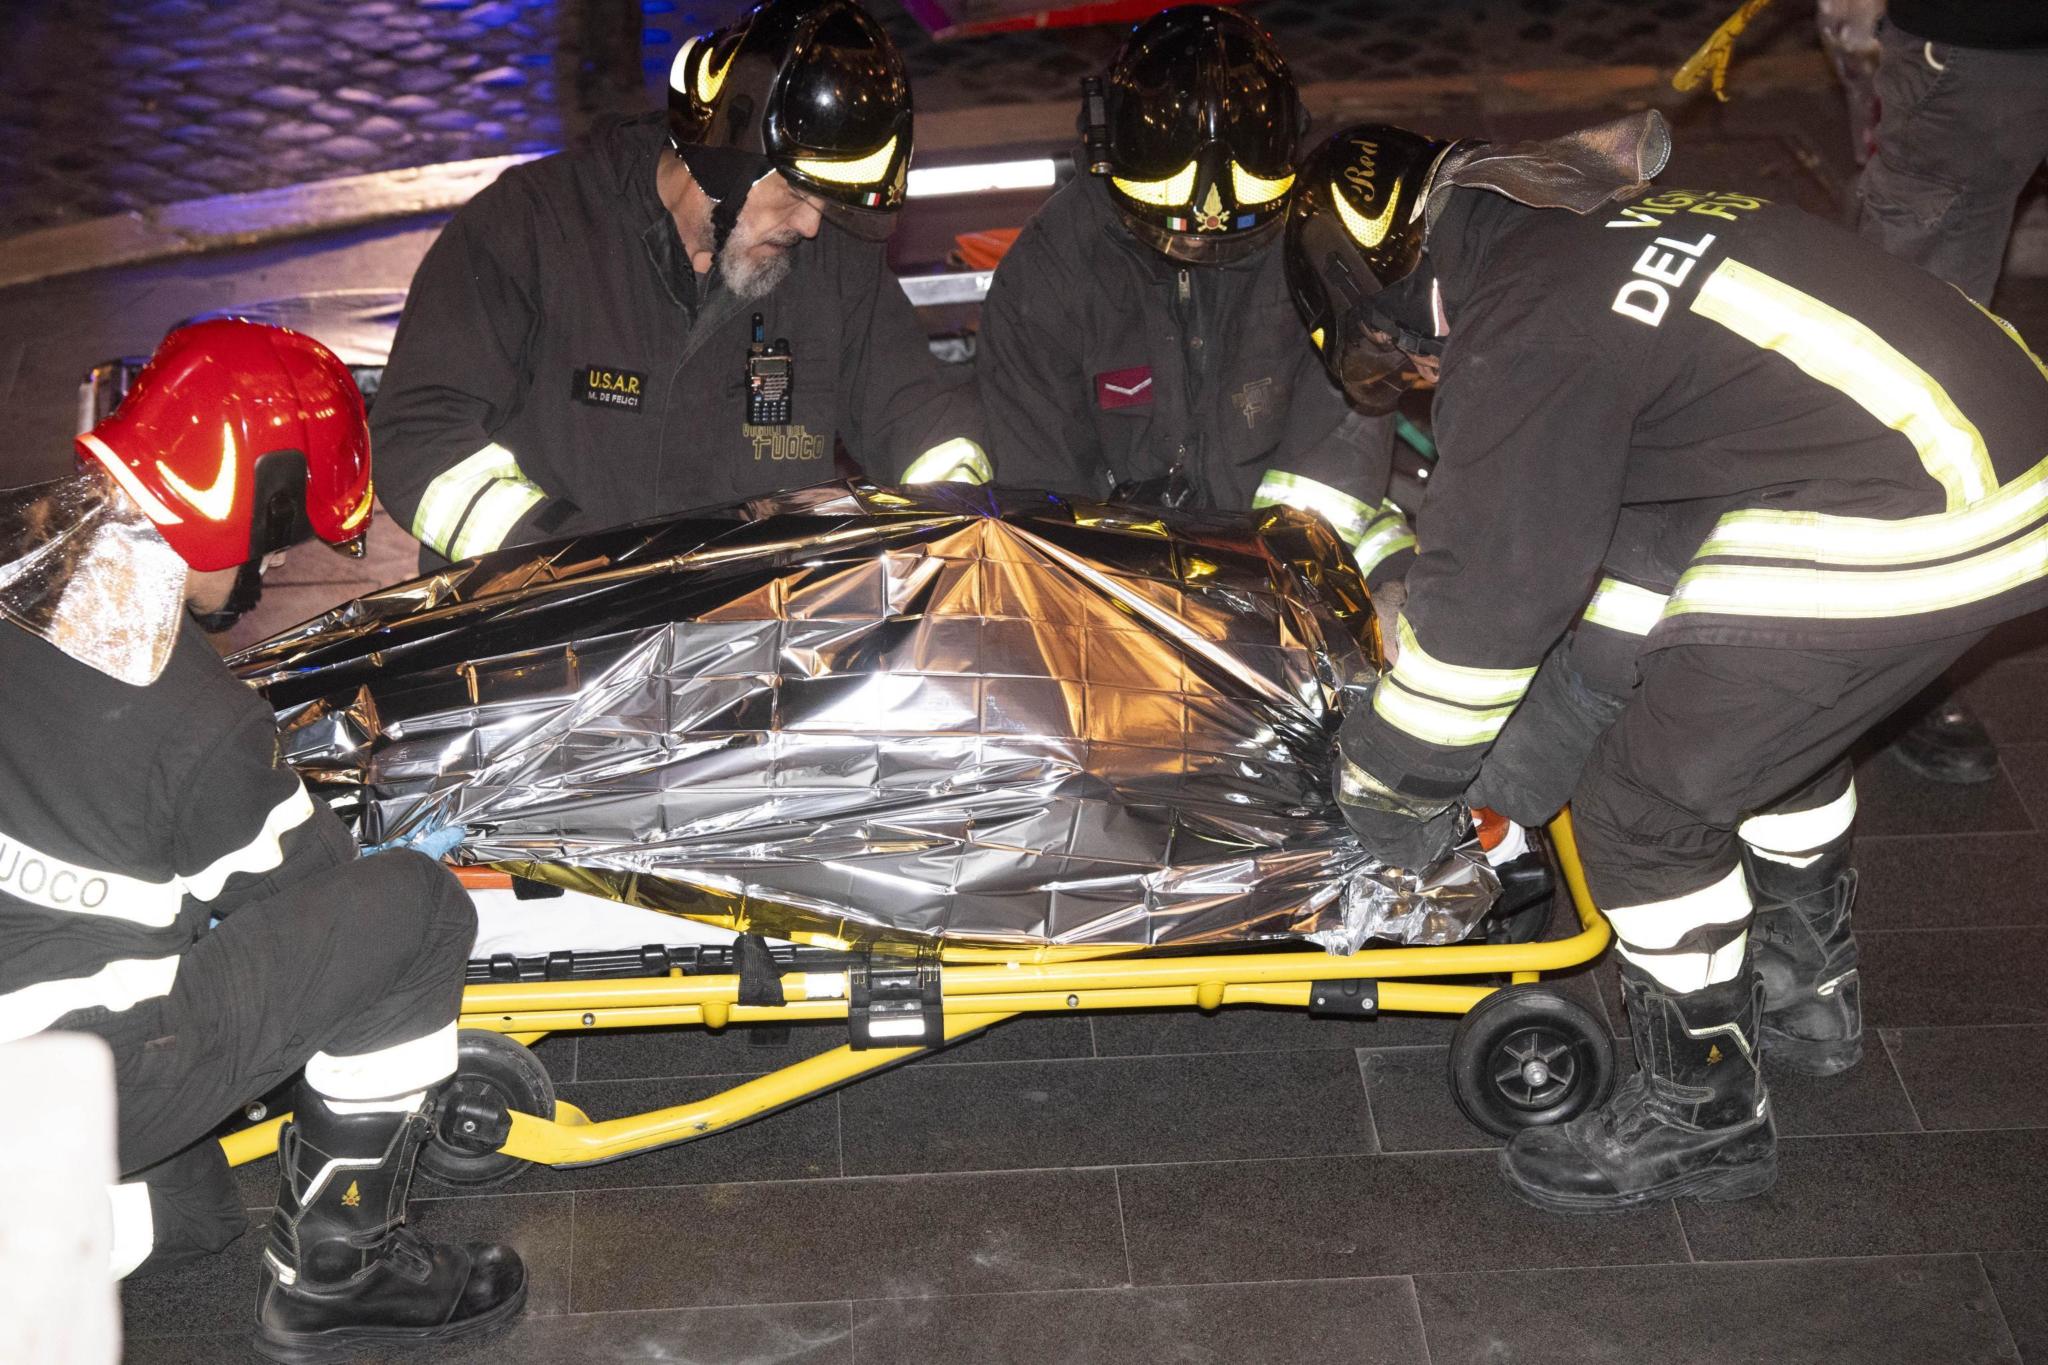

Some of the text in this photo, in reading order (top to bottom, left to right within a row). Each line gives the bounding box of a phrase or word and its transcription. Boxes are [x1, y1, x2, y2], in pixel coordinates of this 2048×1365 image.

[1611, 233, 1716, 327] DEL
[589, 369, 641, 395] U.S.A.R.
[600, 392, 611, 402] DE
